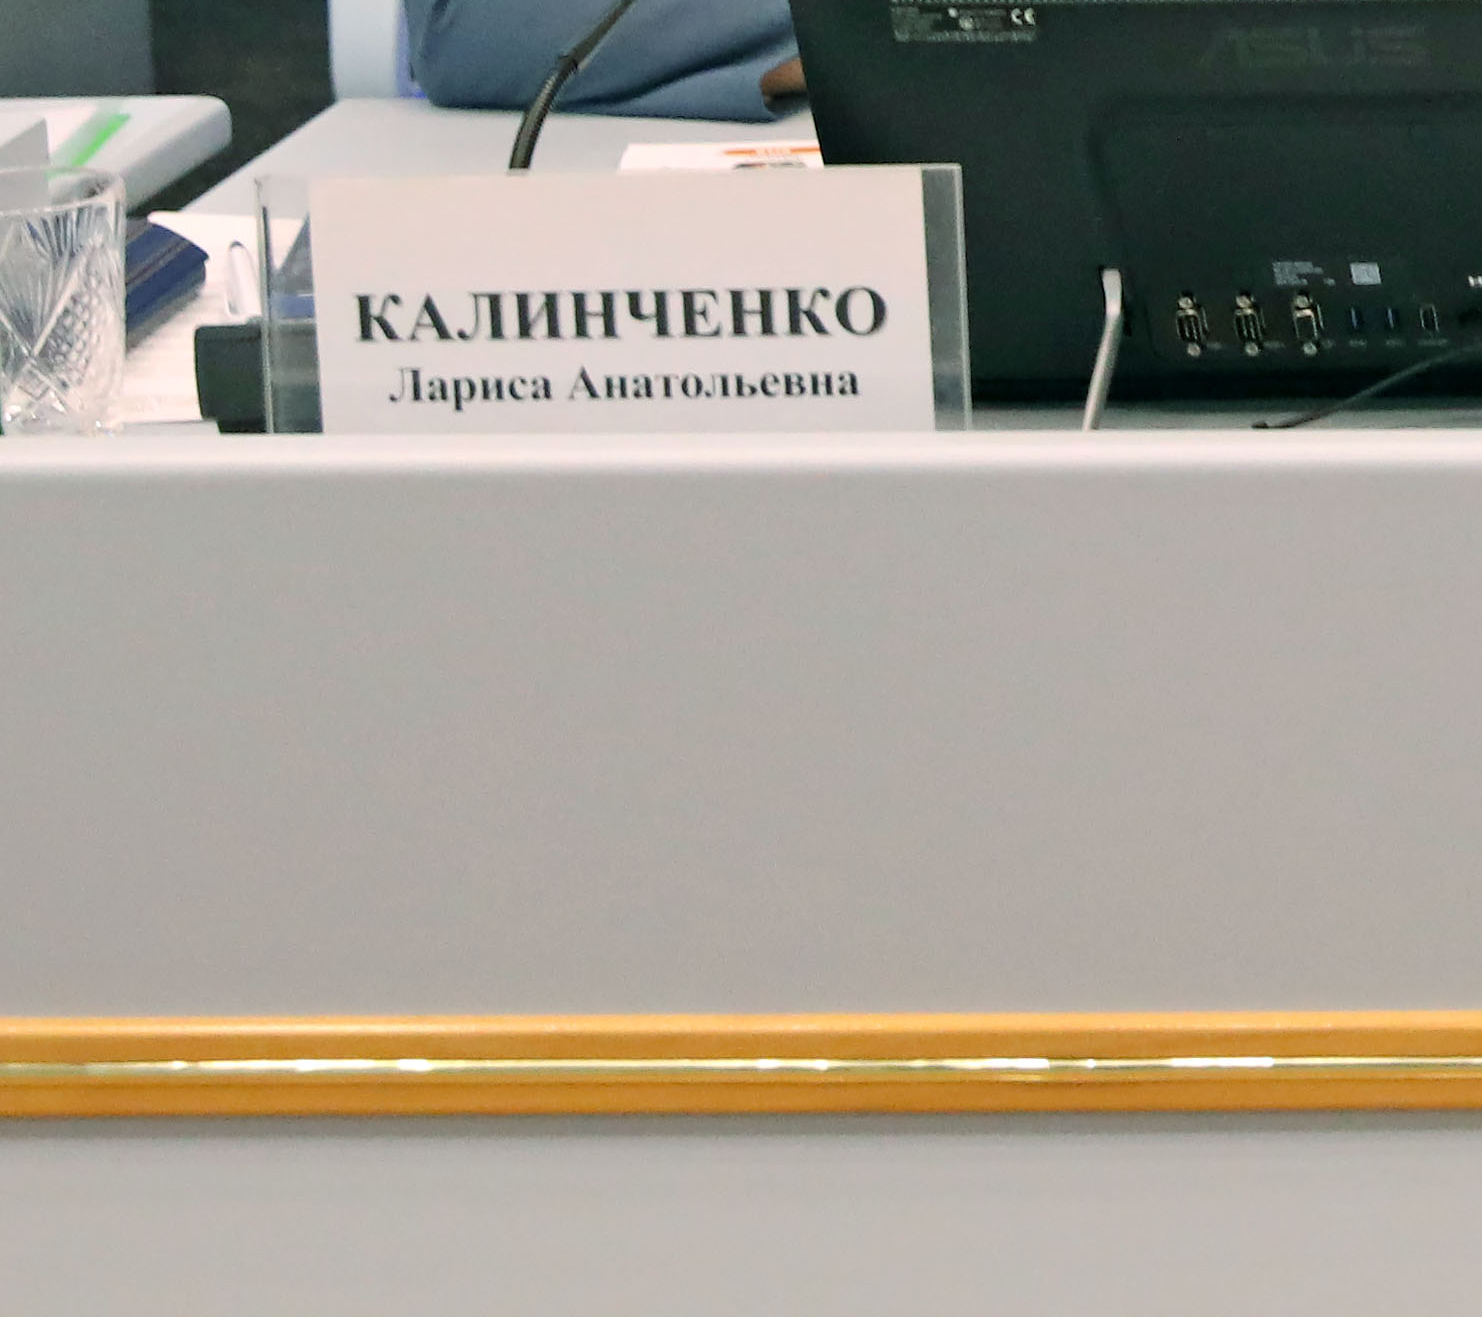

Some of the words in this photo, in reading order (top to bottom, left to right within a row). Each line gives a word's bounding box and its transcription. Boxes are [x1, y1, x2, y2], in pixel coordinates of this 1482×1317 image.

[355, 285, 888, 344] КАЛИНЧЕНКО
[388, 367, 554, 413] Лариса
[567, 366, 860, 401] Анатольевна
